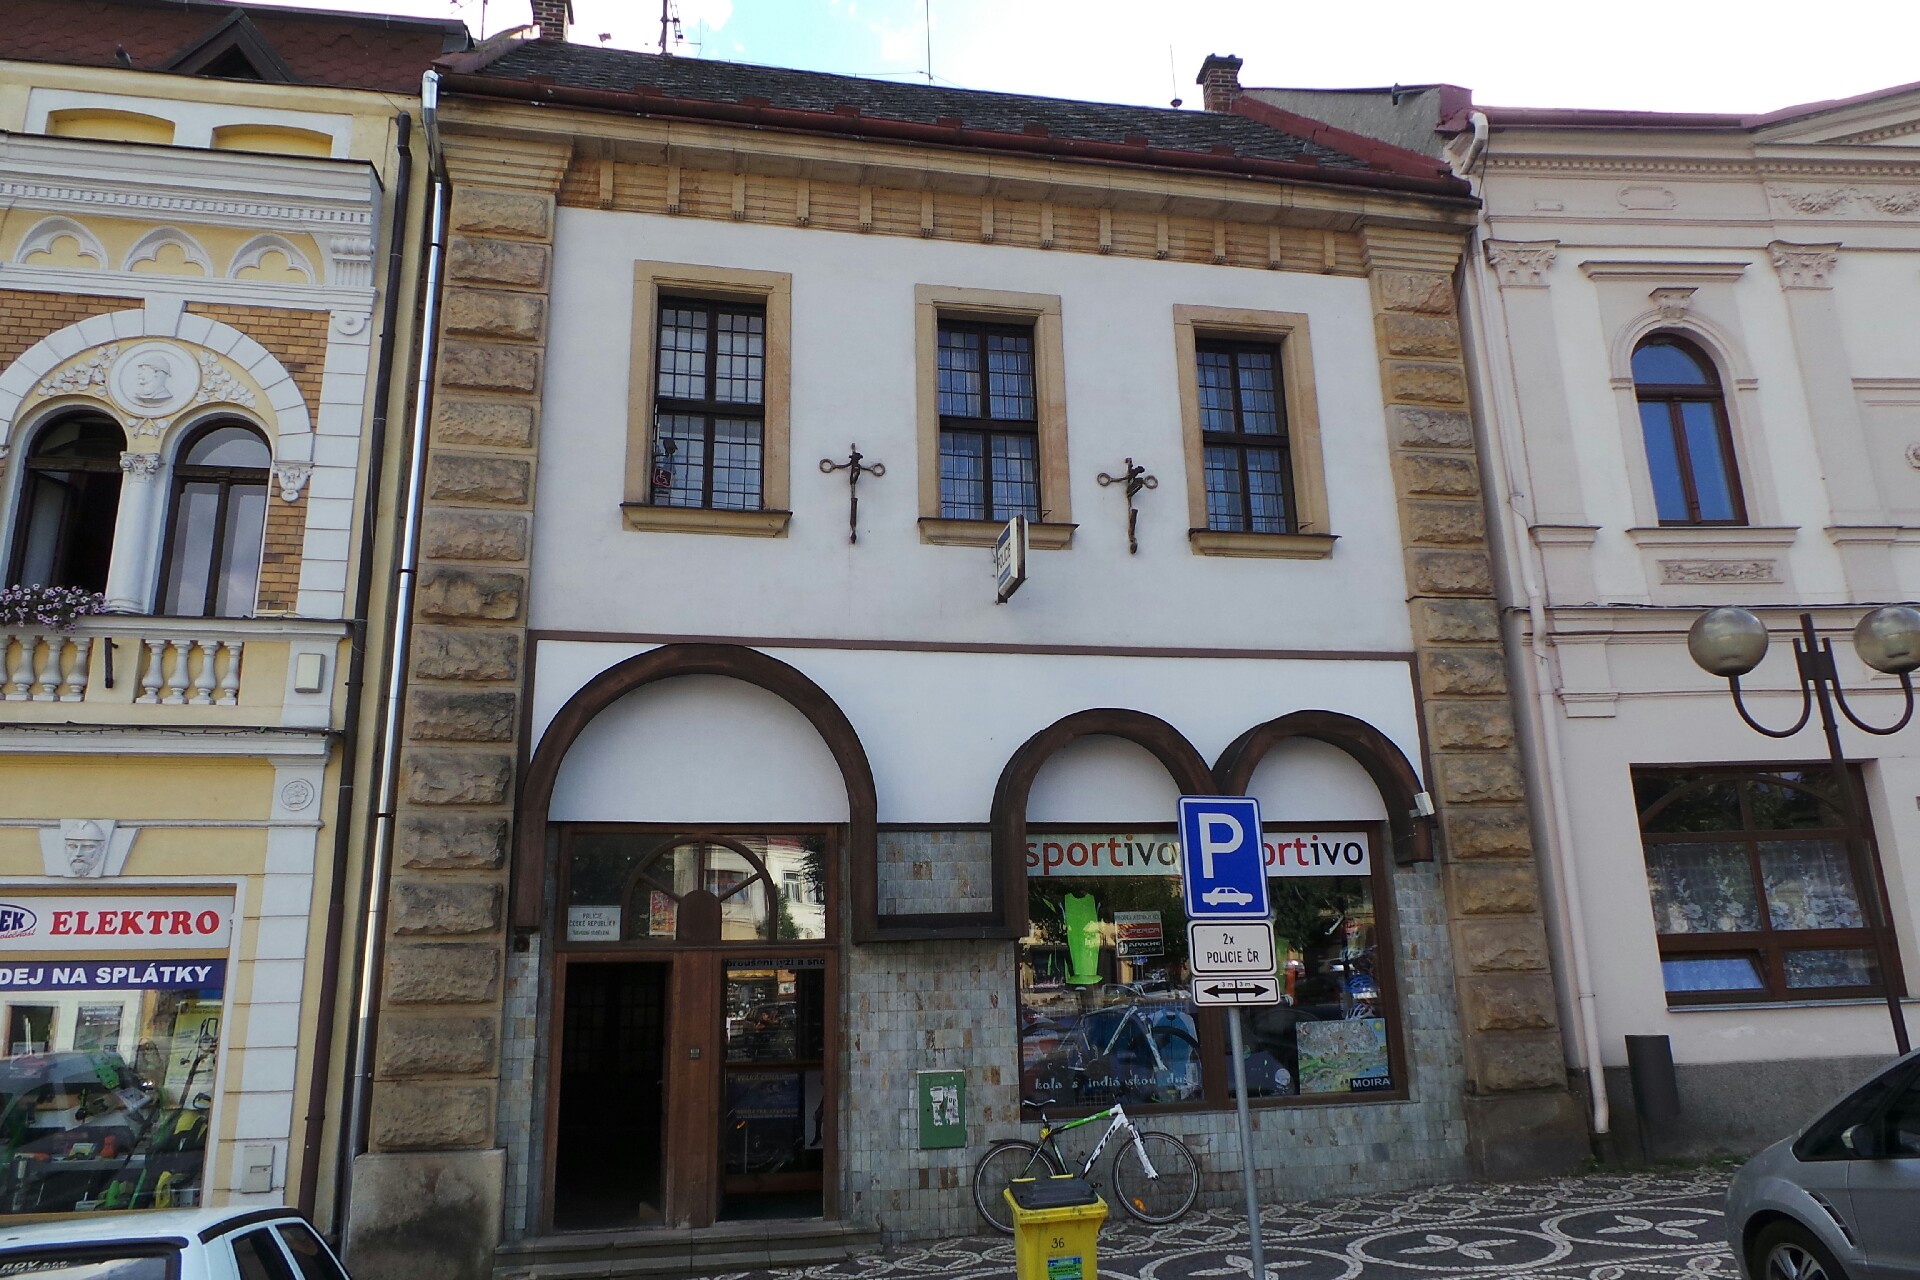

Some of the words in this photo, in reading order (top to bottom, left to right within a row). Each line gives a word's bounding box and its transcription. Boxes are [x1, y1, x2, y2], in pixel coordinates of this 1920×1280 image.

[1026, 834, 1177, 875] sportivo
[1198, 813, 1244, 878] P
[1263, 835, 1363, 866] ortivo
[0, 910, 25, 932] EK
[49, 910, 220, 936] ELEKTRO
[1223, 933, 1235, 945] 2x
[1206, 950, 1243, 964] POLICIE
[1247, 947, 1259, 963] ČR
[0, 967, 43, 985] DEJ
[51, 967, 88, 984] NA
[95, 963, 212, 984] SPLÁTKY
[1035, 1077, 1063, 1090] kola
[1072, 1080, 1079, 1089] s
[1352, 1078, 1390, 1088] MOIRA
[1051, 1237, 1065, 1249] 36
